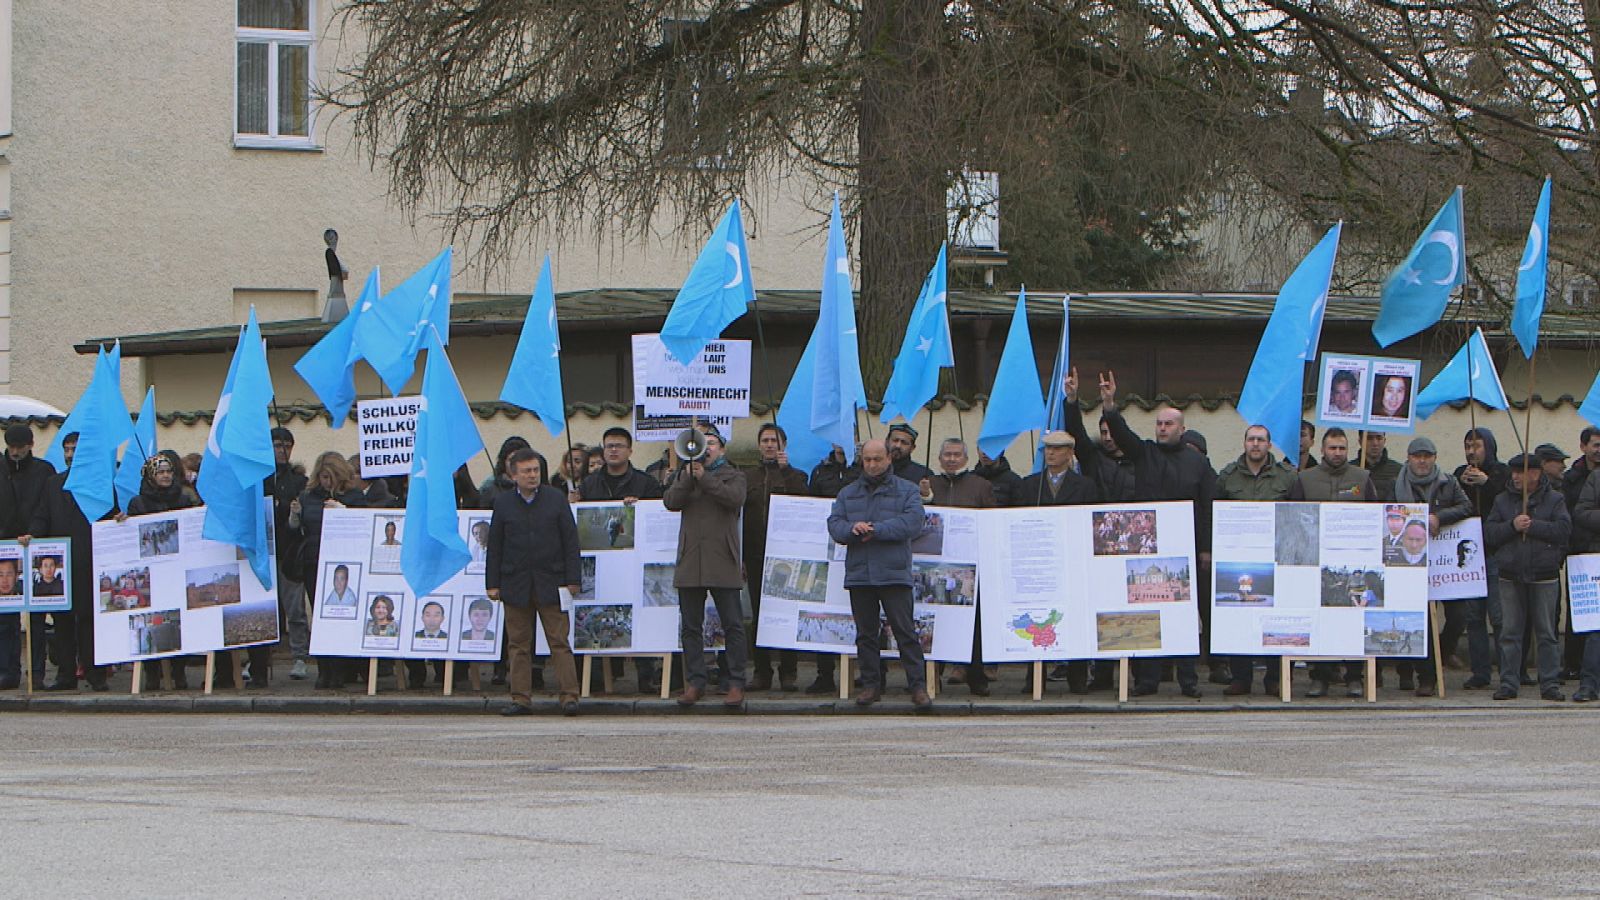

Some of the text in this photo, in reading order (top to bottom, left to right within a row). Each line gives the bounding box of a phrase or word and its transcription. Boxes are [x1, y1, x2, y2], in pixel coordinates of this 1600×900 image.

[704, 343, 725, 352] HIER
[704, 355, 726, 363] LAUT
[708, 365, 726, 374] UNS
[646, 386, 748, 400] MENSCHENRECHT
[679, 400, 710, 410] RAUBT!
[362, 418, 418, 435] WILLKÜ
[364, 452, 414, 467] BERAU
[1436, 555, 1453, 566] die
[1571, 573, 1589, 584] WIR
